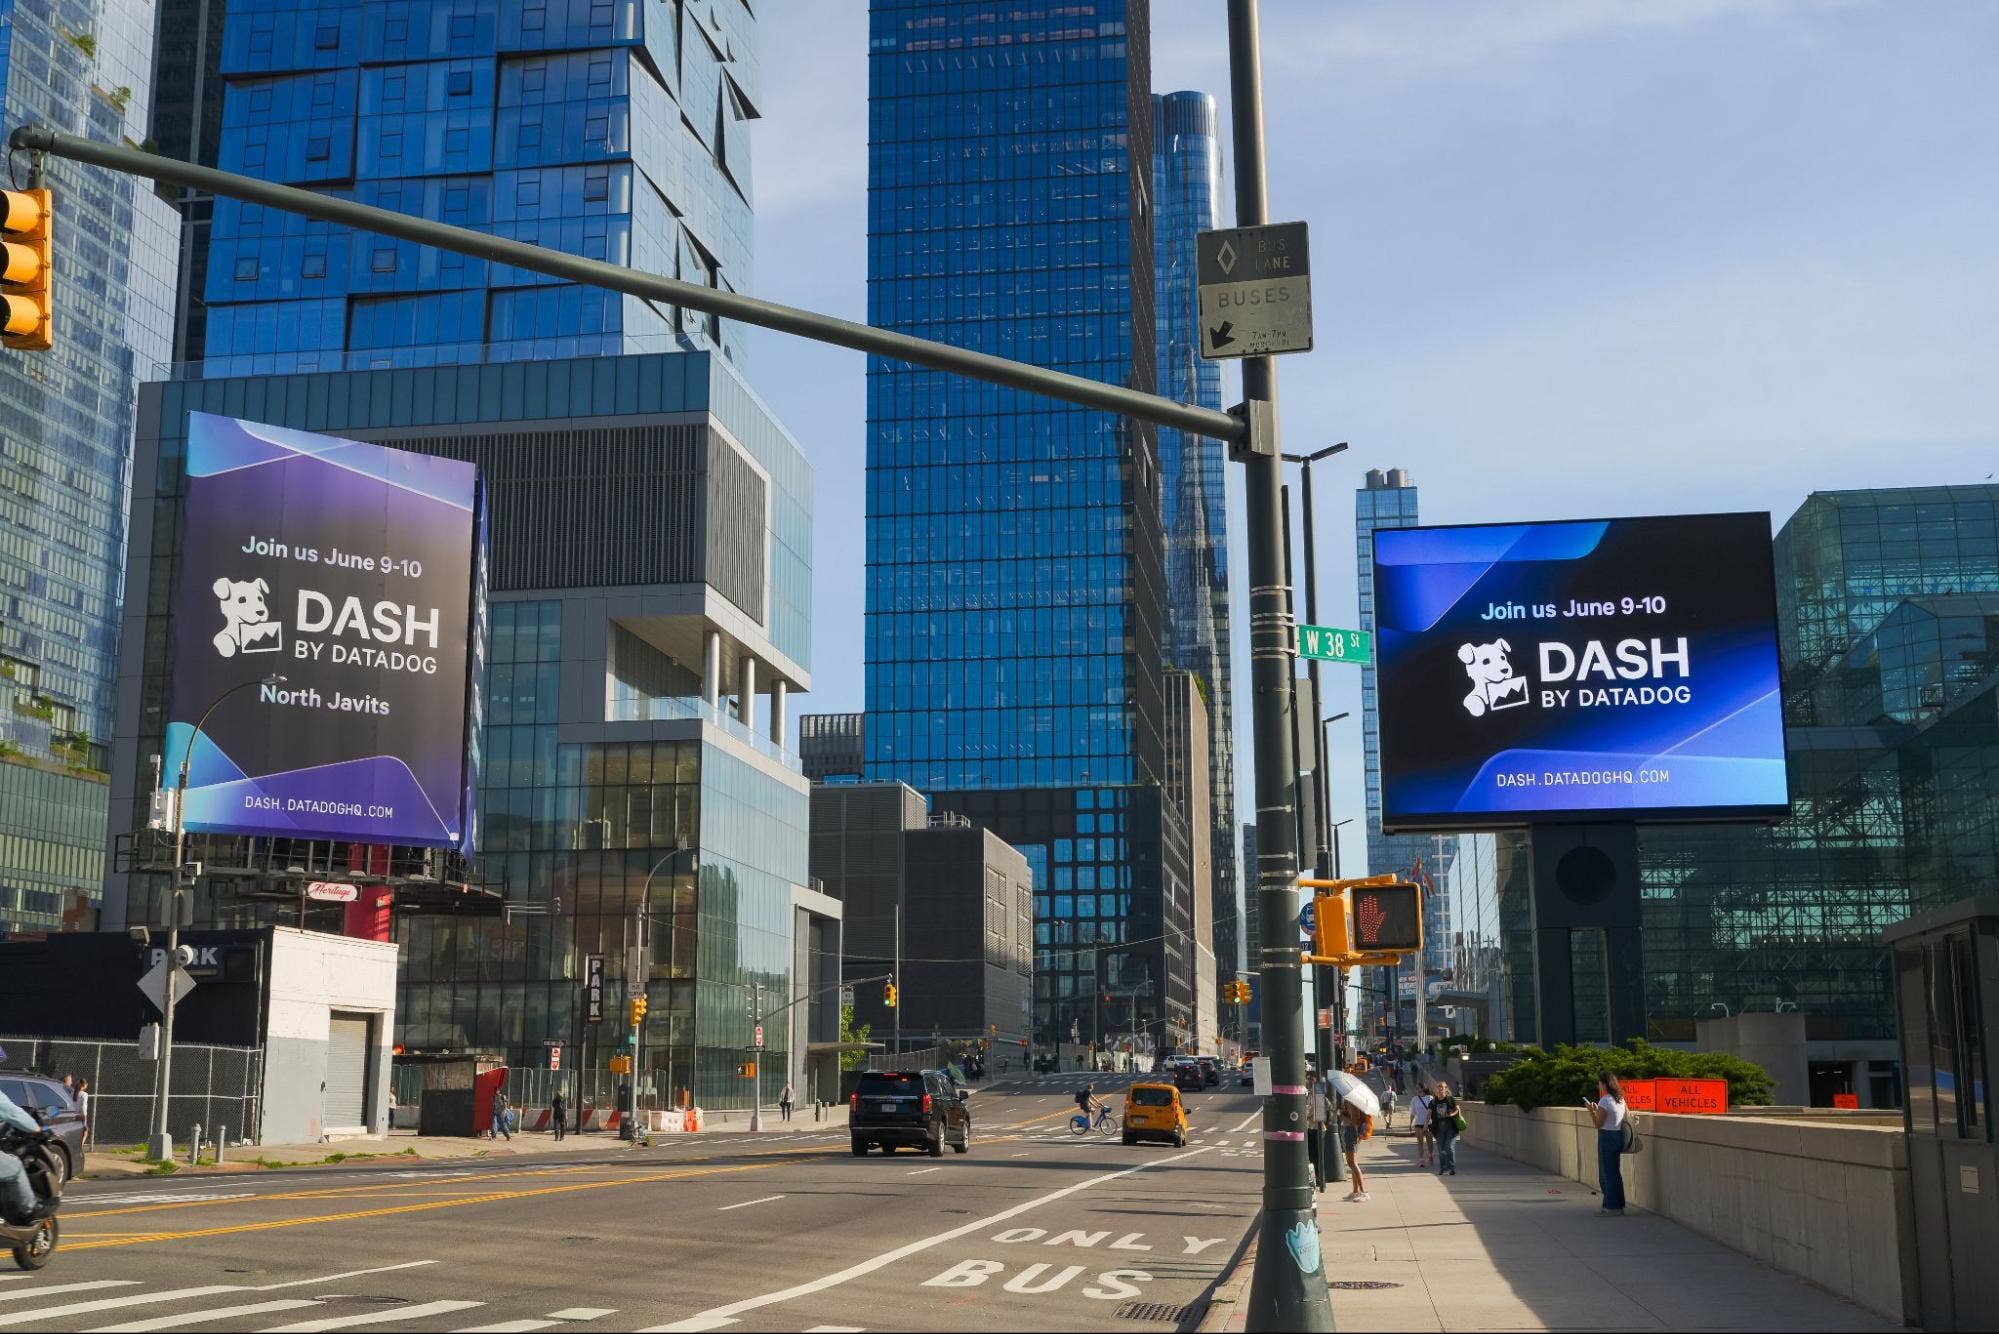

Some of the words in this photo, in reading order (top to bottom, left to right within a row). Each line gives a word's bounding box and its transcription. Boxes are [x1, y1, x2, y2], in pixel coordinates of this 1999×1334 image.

[1219, 287, 1290, 308] BUSES
[241, 535, 289, 559] Join
[294, 543, 319, 562] us
[324, 548, 375, 572] June
[379, 555, 422, 579] 9-10
[296, 588, 440, 648] DASH
[1481, 600, 1527, 621] Join
[1531, 603, 1557, 618] us
[1562, 599, 1615, 618] June
[1621, 596, 1666, 615] 9-10
[1306, 630, 1319, 655] W
[1325, 632, 1345, 657] 38
[1350, 632, 1360, 648] St
[294, 640, 323, 661] BY
[332, 645, 438, 675] DATADOG
[1539, 637, 1690, 682] DASH
[259, 683, 321, 709] North
[327, 691, 391, 716] Javits
[1541, 689, 1570, 708] BY
[1579, 685, 1692, 707] DATADOG
[1496, 769, 1670, 788] DASH.DATADOGHQ.COM
[244, 794, 394, 818] DASH.DATADOGHQ.COM
[150, 947, 218, 966] PK
[589, 960, 601, 1016] PARK
[1625, 1095, 1652, 1104] ICLES
[1664, 1097, 1717, 1109] VEHICLES
[1680, 1085, 1701, 1095] ALL
[990, 1227, 1226, 1254] ONLY
[919, 1258, 1155, 1300] BUS
